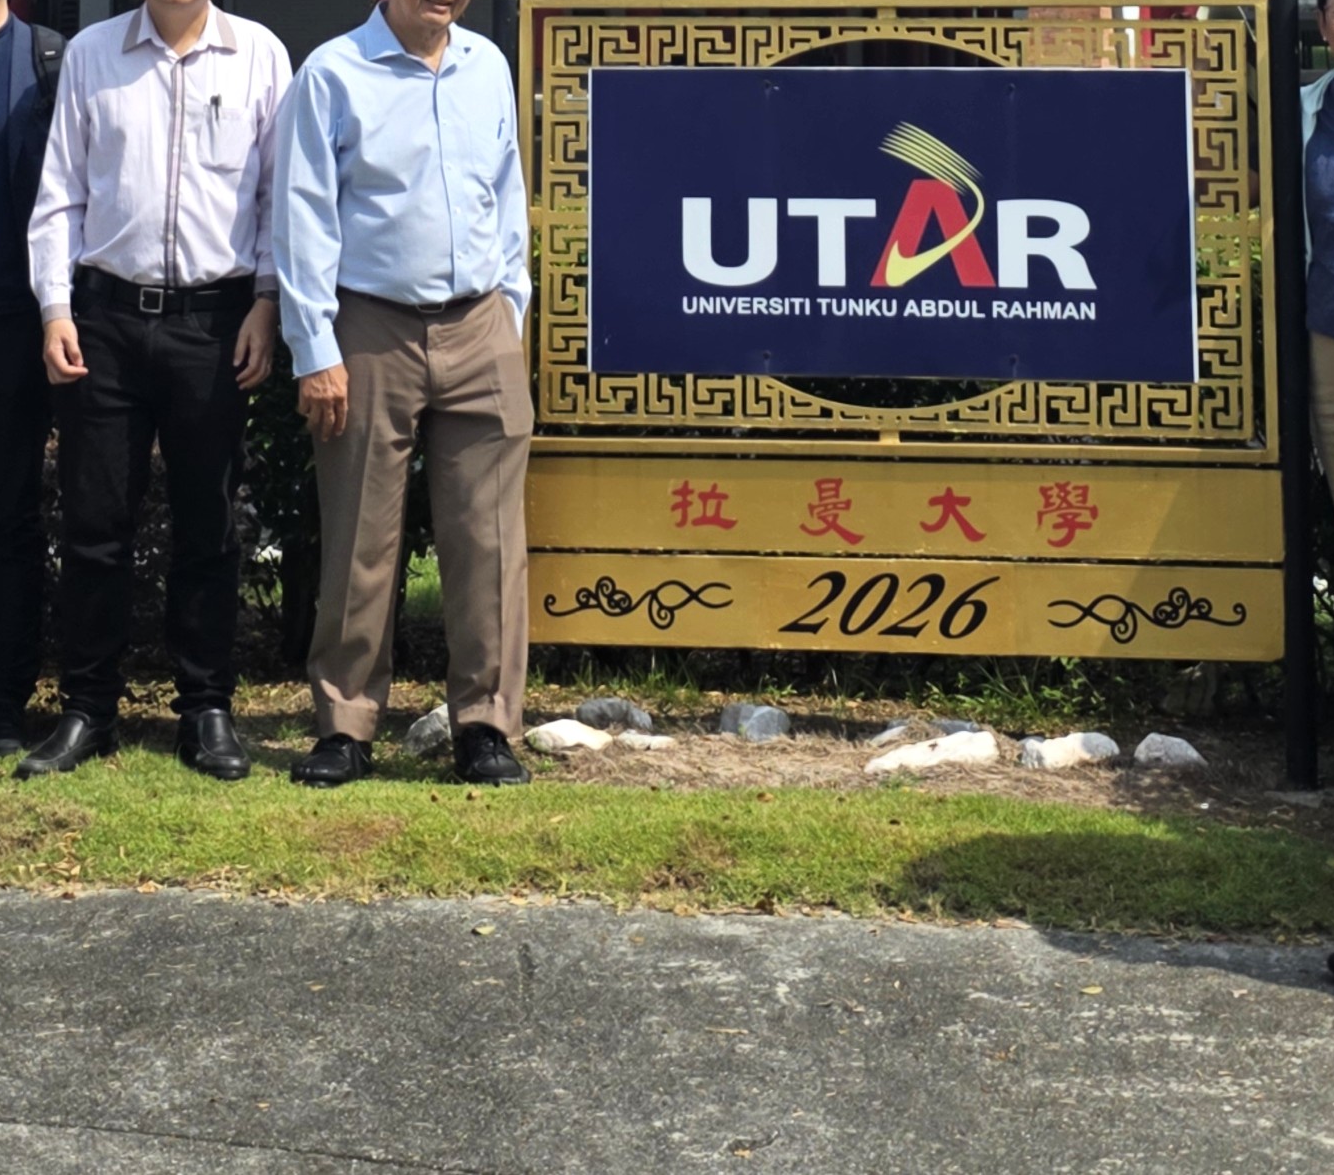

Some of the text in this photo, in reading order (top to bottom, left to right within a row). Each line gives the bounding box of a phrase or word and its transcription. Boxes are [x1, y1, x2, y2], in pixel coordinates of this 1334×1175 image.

[681, 178, 1098, 291] UTAR
[682, 296, 1096, 321] UNIVERSITI TUNKU ABDUL RAHMAN
[670, 478, 1100, 548] 拉曼大學
[779, 571, 1001, 639] 2026
